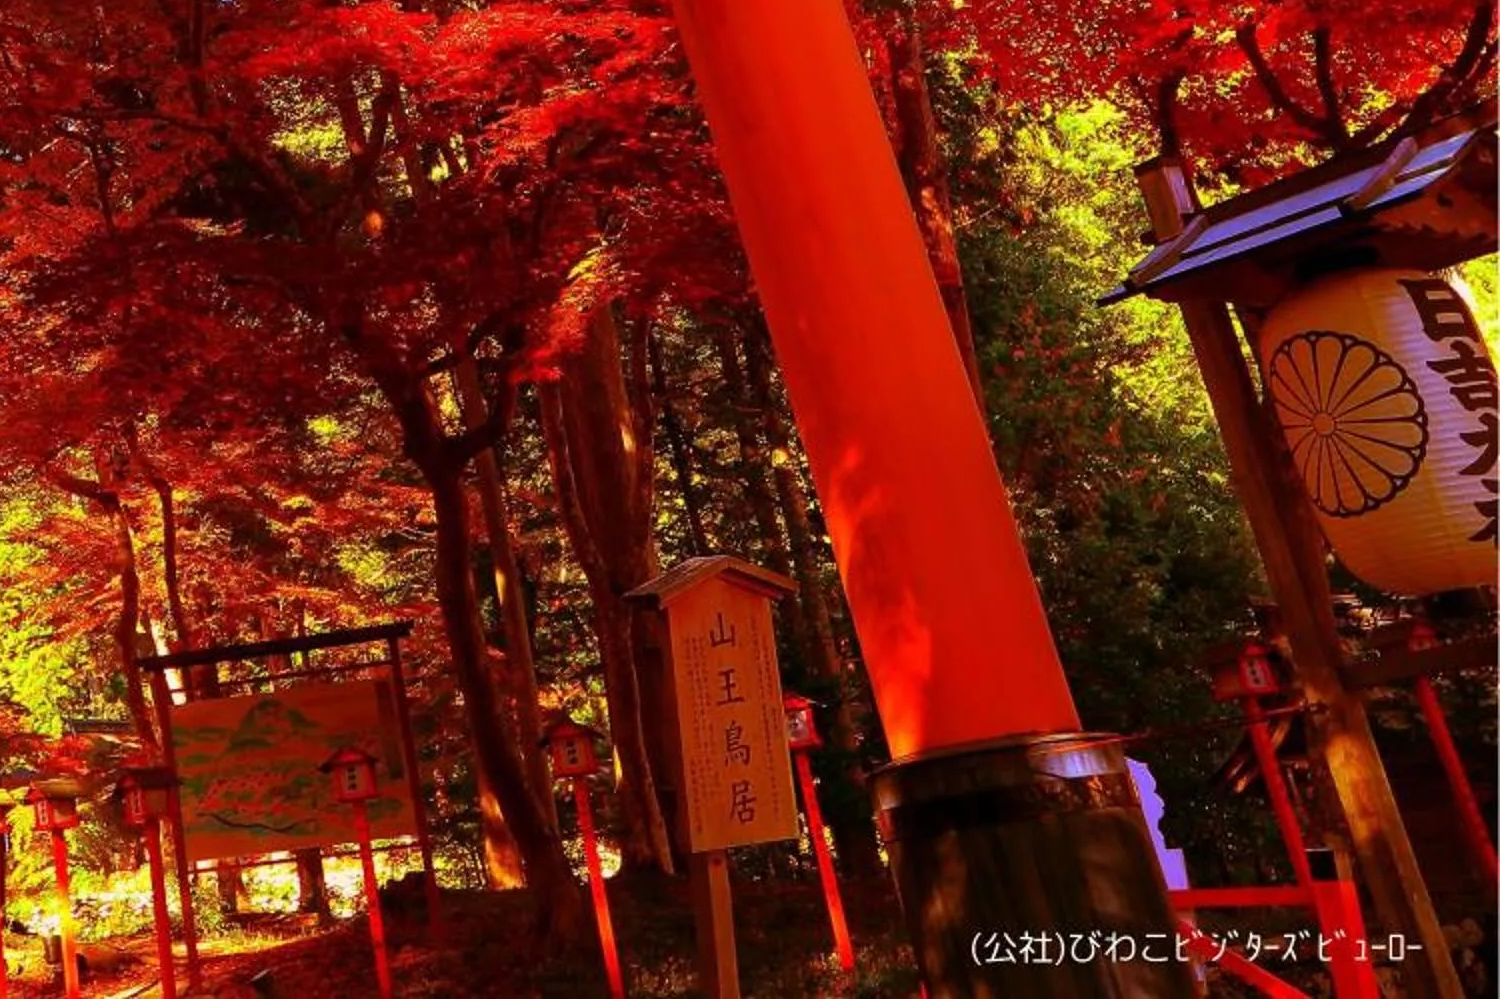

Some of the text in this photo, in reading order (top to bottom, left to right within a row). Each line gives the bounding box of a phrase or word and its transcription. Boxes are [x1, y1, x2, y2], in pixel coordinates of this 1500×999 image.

[1396, 278, 1497, 550] 日吉大
[709, 612, 757, 825] 山王鳥居
